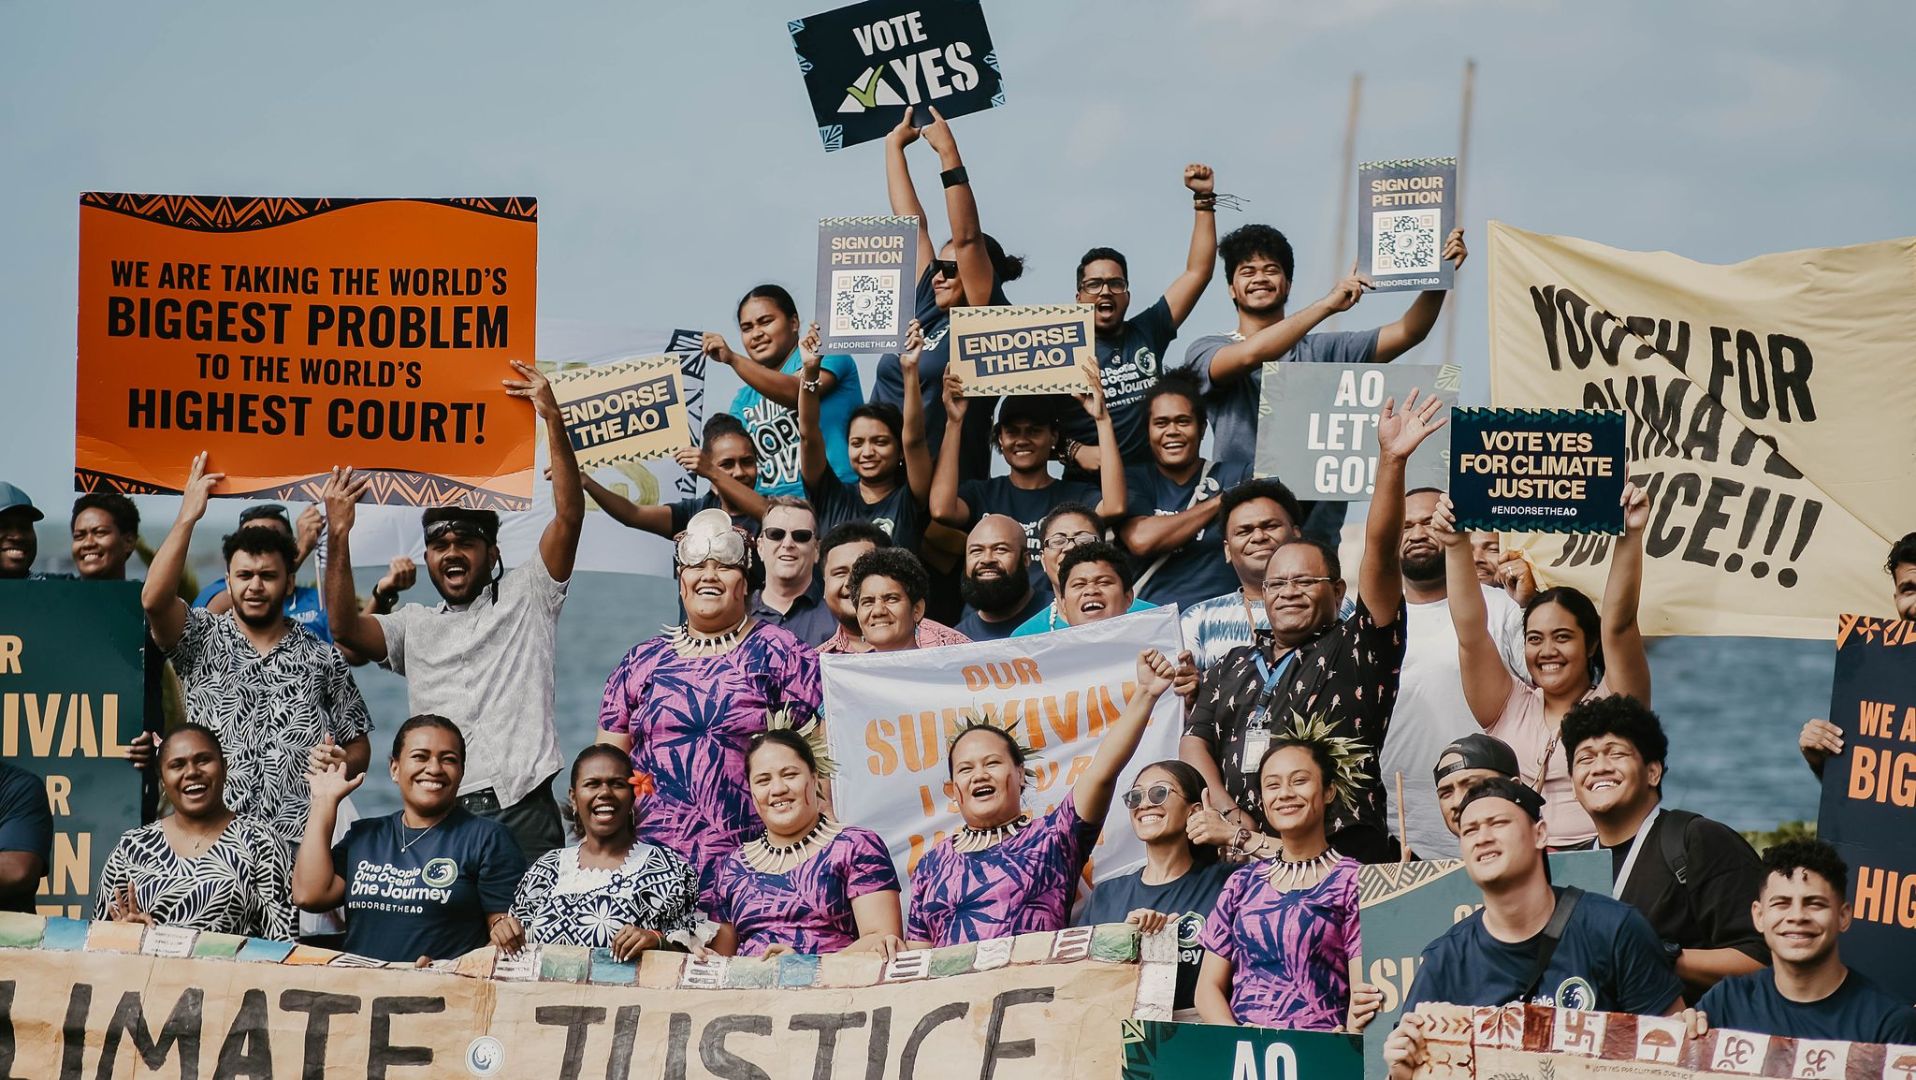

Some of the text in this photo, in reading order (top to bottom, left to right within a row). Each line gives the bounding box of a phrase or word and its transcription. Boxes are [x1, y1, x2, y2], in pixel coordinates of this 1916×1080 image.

[852, 10, 927, 56] VOTE
[888, 41, 979, 105] YES
[1371, 177, 1444, 193] SIGN OUR
[1371, 191, 1442, 207] PETITION
[831, 236, 904, 250] SIGN OUR
[831, 251, 903, 265] PETITION
[111, 260, 507, 296] WE ARE TAKING THE WORLD'S
[108, 296, 509, 349] BIGGEST PROBLEM
[964, 325, 1079, 355] ENDORSE
[828, 341, 897, 349] #ENDORSETHEAO
[981, 348, 1066, 374] THE AO
[196, 353, 422, 389] TO THE WORLD'S
[1118, 377, 1159, 395] Journe
[1708, 326, 1817, 424] FOR
[561, 381, 670, 427] ENDORSE
[1334, 370, 1384, 408] AO
[128, 388, 486, 445] HIGHEST COURT!
[575, 409, 660, 446] THE AO
[1307, 413, 1381, 451] LET'
[1481, 431, 1593, 453] VOTE YES
[1315, 455, 1378, 494] GO!
[1460, 454, 1612, 477] FOR CLIMATE
[1488, 478, 1586, 500] JUSTICE
[1491, 506, 1577, 516] #ENDORSETHEAO
[962, 657, 1042, 692] OUR
[1859, 700, 1896, 739] WE
[1849, 745, 1916, 808] BIG
[354, 870, 416, 887] One Ocean
[358, 860, 422, 879] One People
[351, 881, 452, 904] One Journey
[1232, 1041, 1298, 1080] AO
